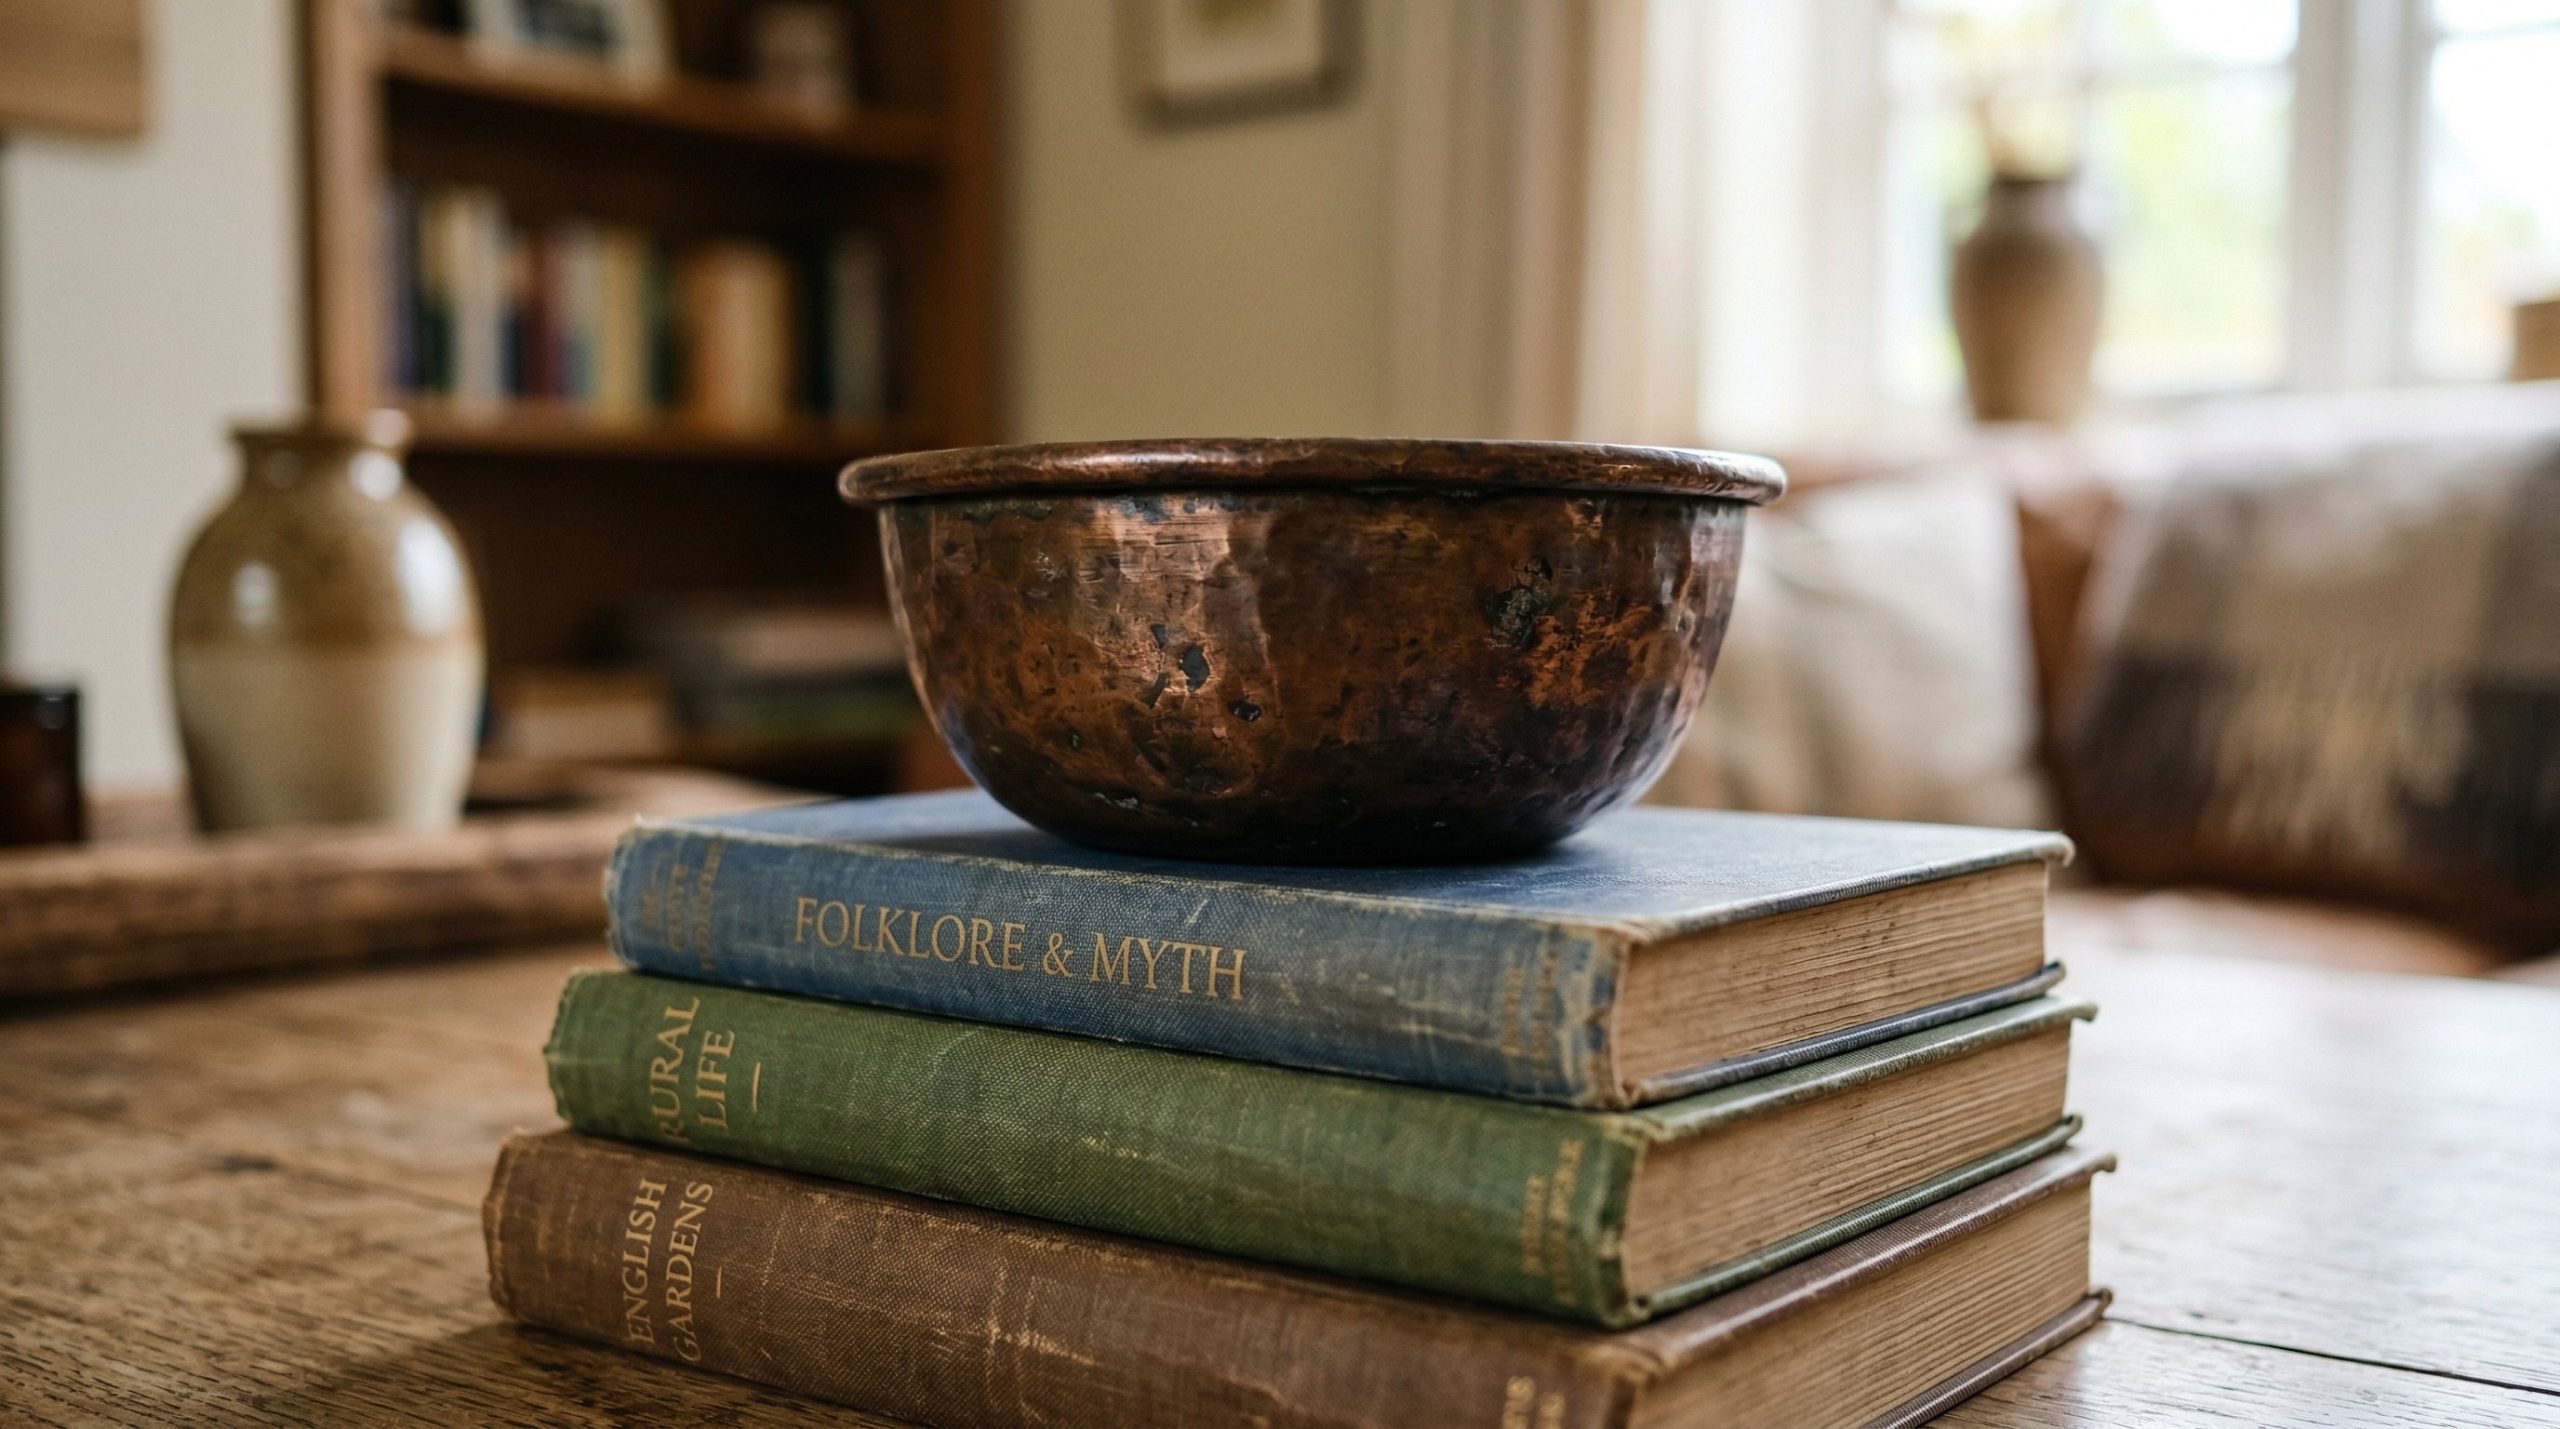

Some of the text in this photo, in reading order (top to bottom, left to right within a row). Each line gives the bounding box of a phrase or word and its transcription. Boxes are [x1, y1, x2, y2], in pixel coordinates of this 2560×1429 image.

[794, 896, 1026, 972] FOLKLORE
[1042, 932, 1074, 978] &
[1090, 932, 1247, 1000] MYTH
[650, 996, 701, 1144] RURAL
[696, 1029, 736, 1131] LIFE
[622, 1178, 668, 1345] ENGLISH
[665, 1181, 714, 1362] GARDENS
